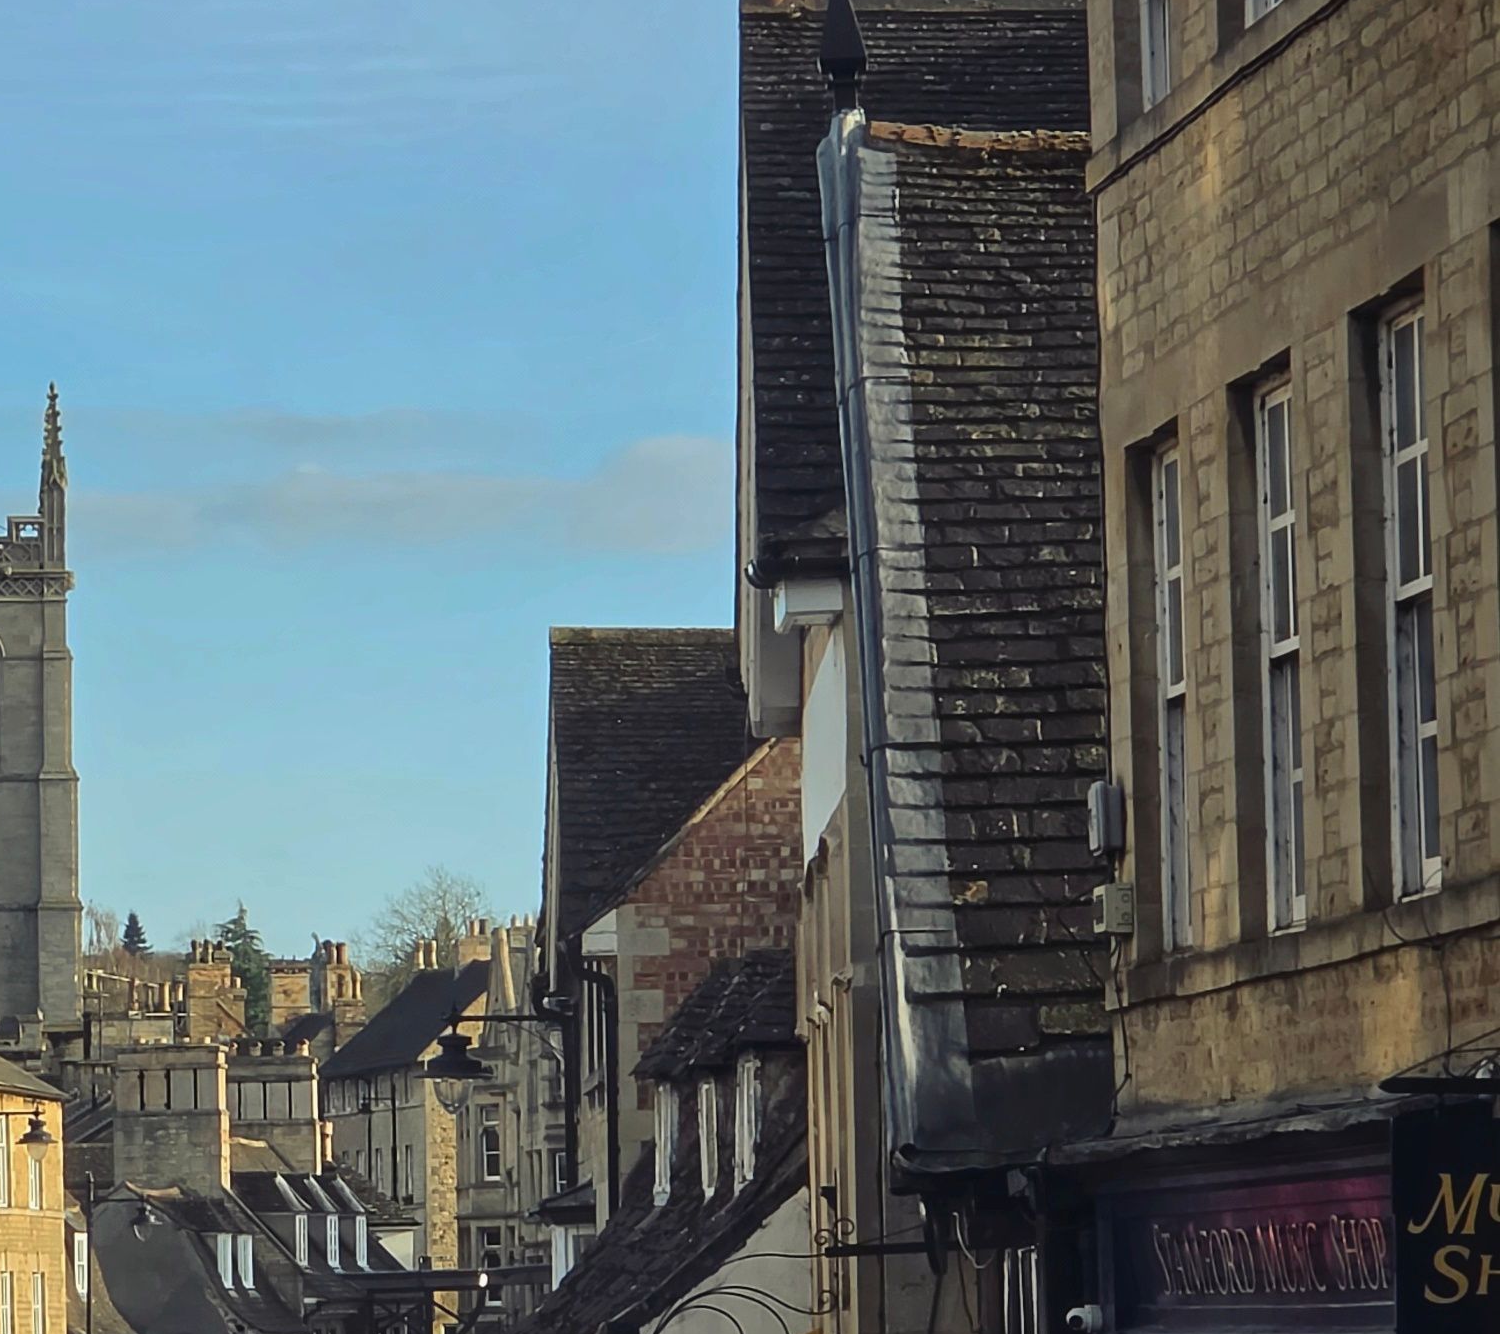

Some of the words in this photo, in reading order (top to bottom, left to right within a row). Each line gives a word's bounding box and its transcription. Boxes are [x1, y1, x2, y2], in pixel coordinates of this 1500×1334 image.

[1153, 1223, 1256, 1295] STAMFORD
[1256, 1218, 1327, 1293] MUSIC
[1329, 1213, 1389, 1292] SHOP
